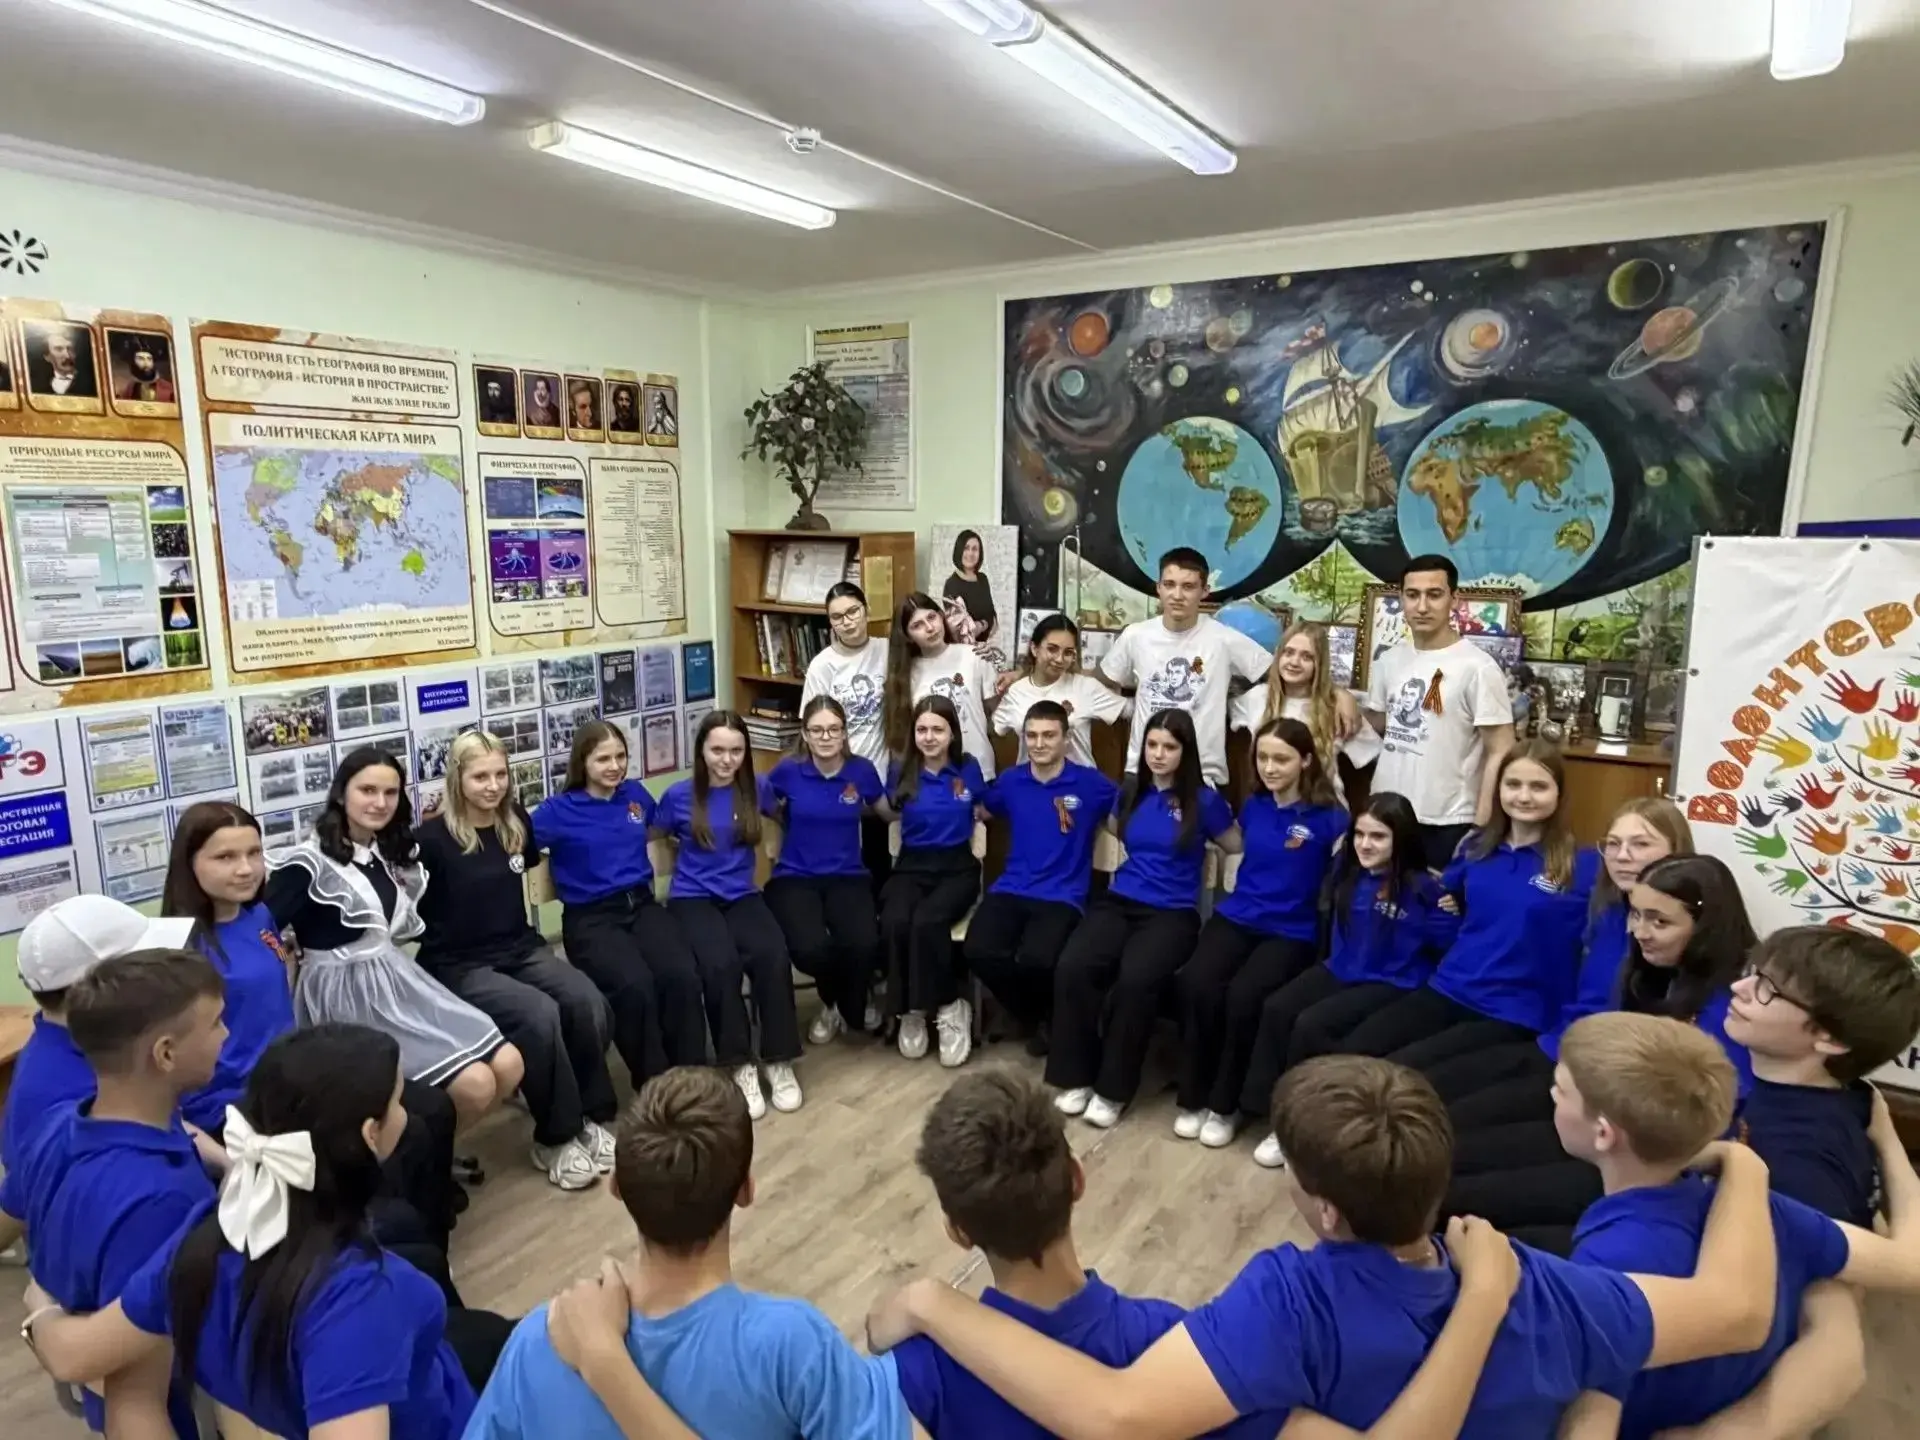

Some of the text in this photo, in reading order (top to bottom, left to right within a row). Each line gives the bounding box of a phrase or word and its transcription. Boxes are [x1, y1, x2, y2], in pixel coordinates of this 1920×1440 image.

[211, 365, 218, 375] А
[222, 366, 293, 382] ГЕОГРАФИЯ
[303, 374, 354, 387] ИСТОРИЯ
[358, 378, 365, 388] В
[286, 354, 315, 367] ЕСТЬ
[317, 358, 380, 373] ГЕОГРАФИЯ
[382, 365, 396, 375] ВО
[399, 366, 449, 380] ВРЕМЕНИ,
[351, 395, 451, 410] ЖАН ЖАК ЭЛИЗЕ РЕКЛЮ
[242, 424, 436, 445] ПОЛИТИЧЕСКАЯ КАРТА МИРА
[9, 446, 172, 460] ПРИРОДНЫЕ РЕССУРСЫ МИРА
